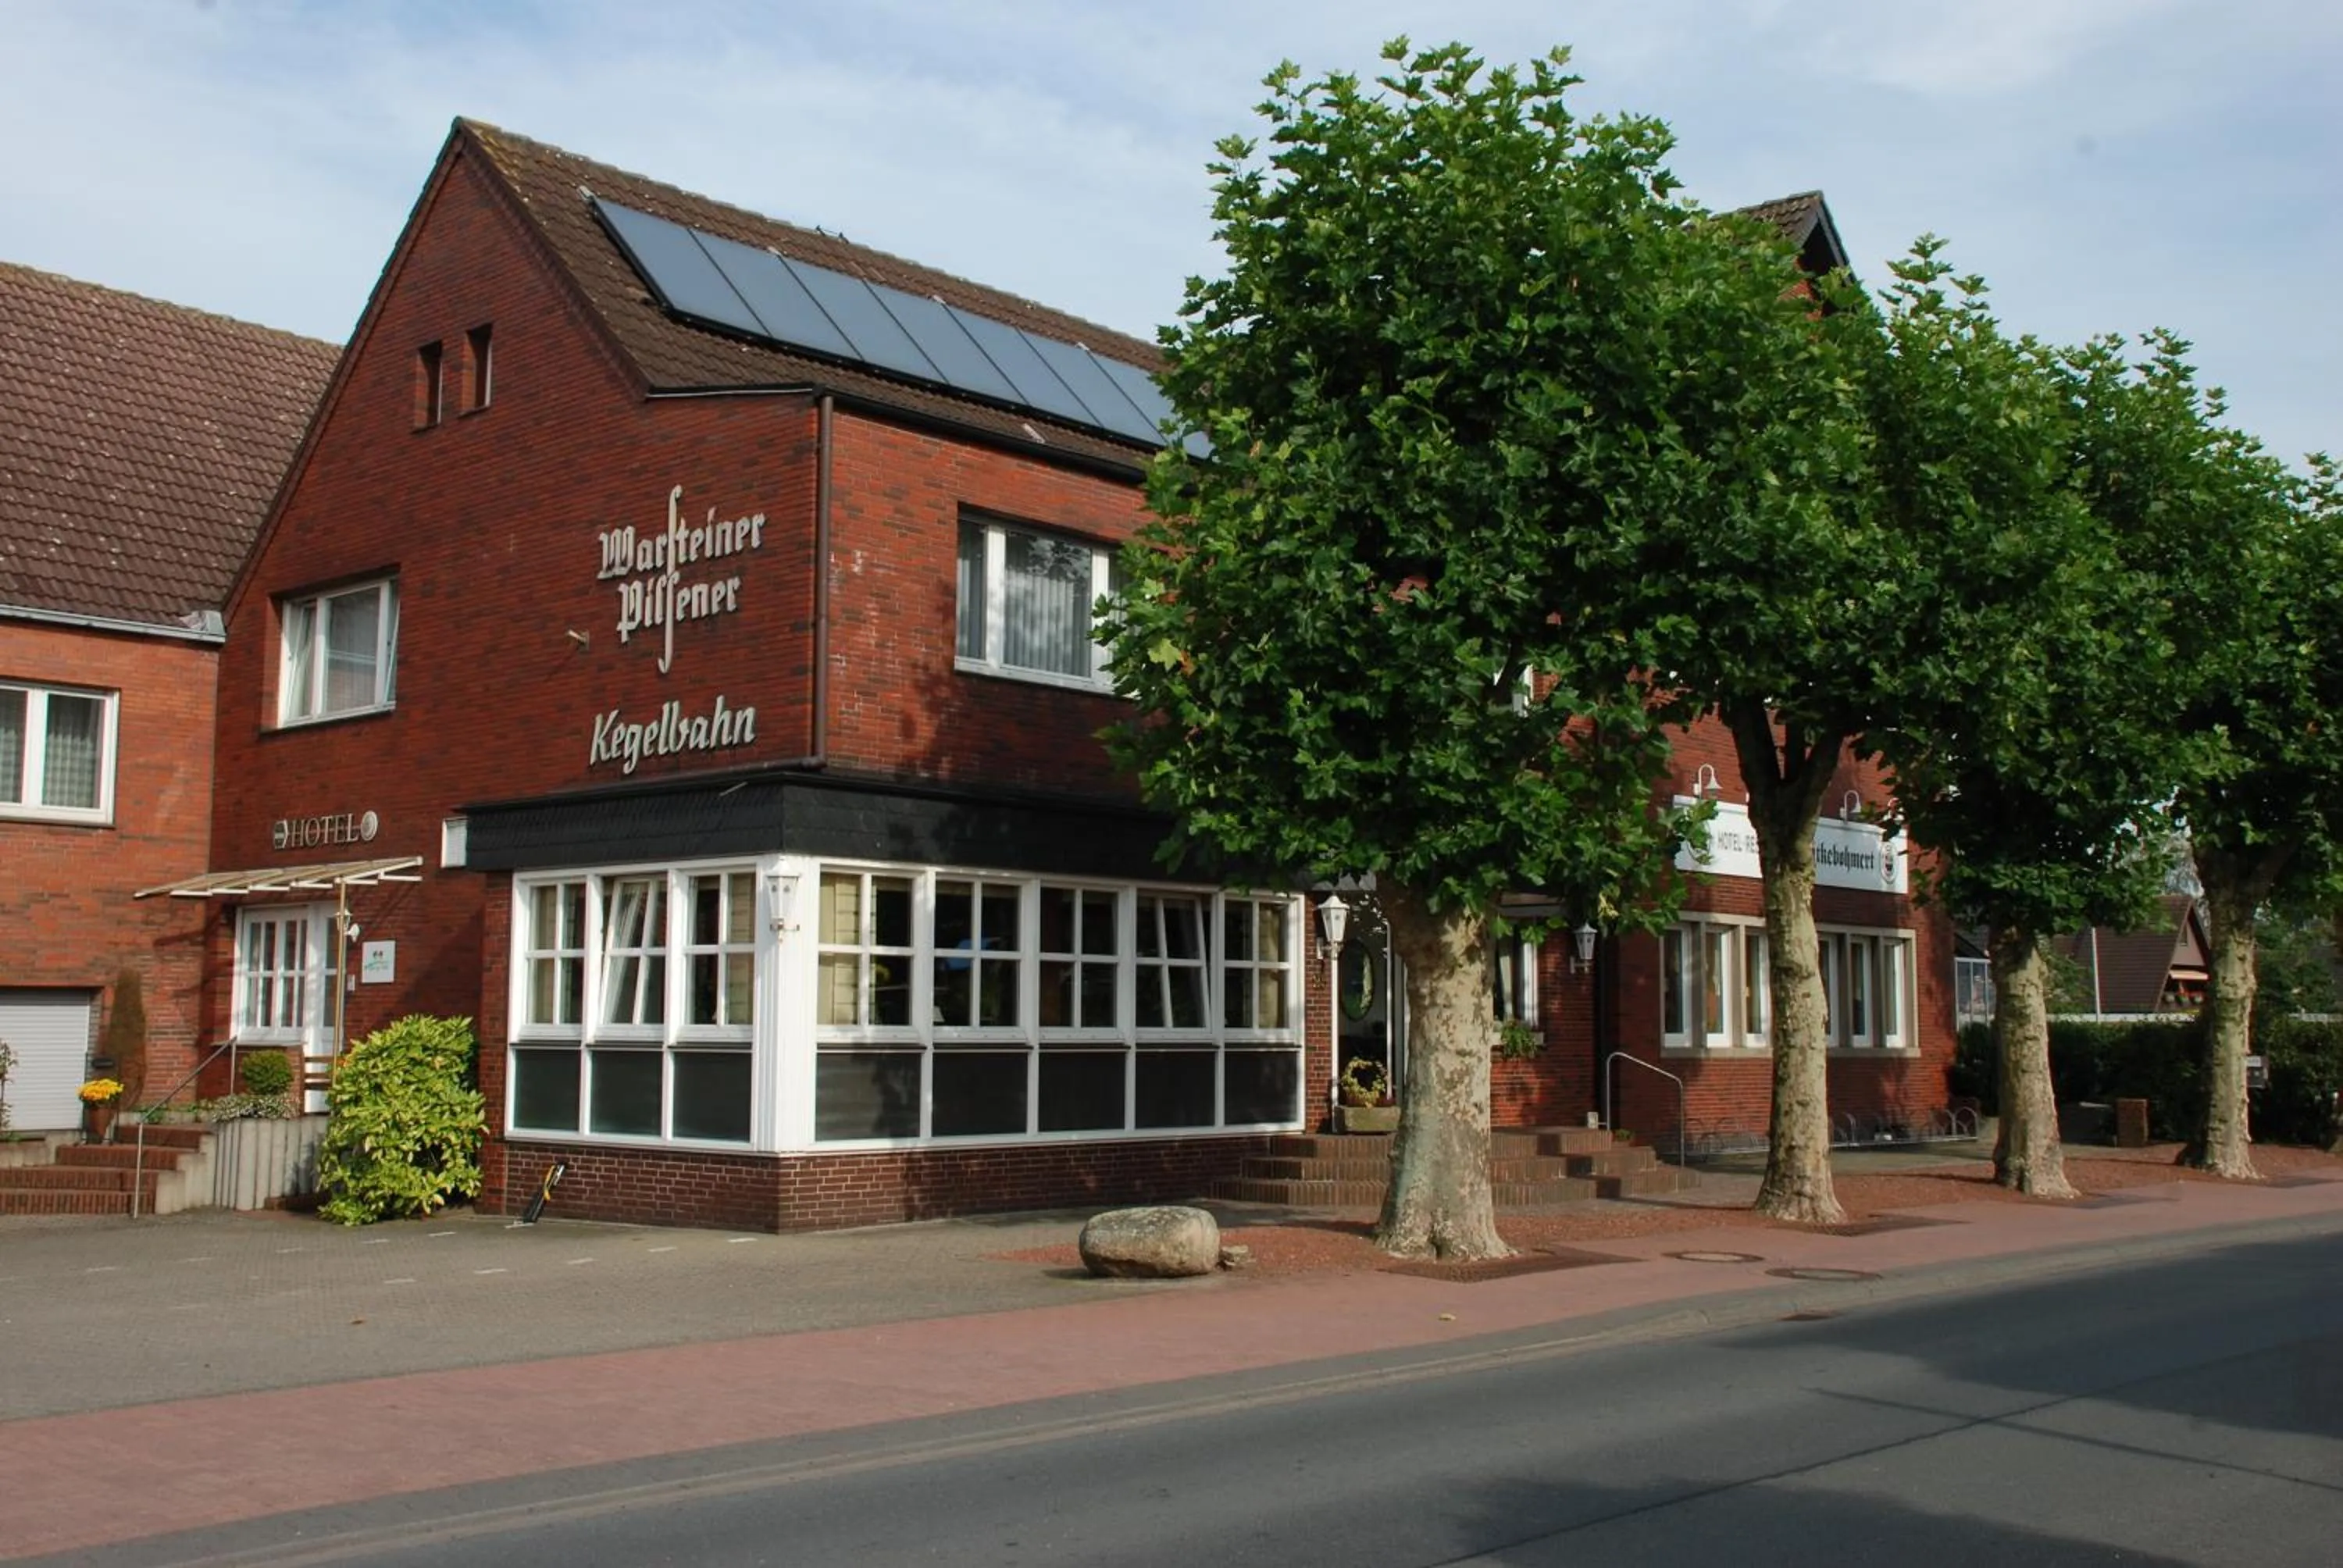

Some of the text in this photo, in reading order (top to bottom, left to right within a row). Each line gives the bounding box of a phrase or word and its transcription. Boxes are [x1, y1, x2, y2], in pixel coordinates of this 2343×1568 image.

[590, 695, 756, 775] Kegelbahn
[291, 812, 359, 847] HOTEL
[1717, 831, 1742, 852] HOTEL
